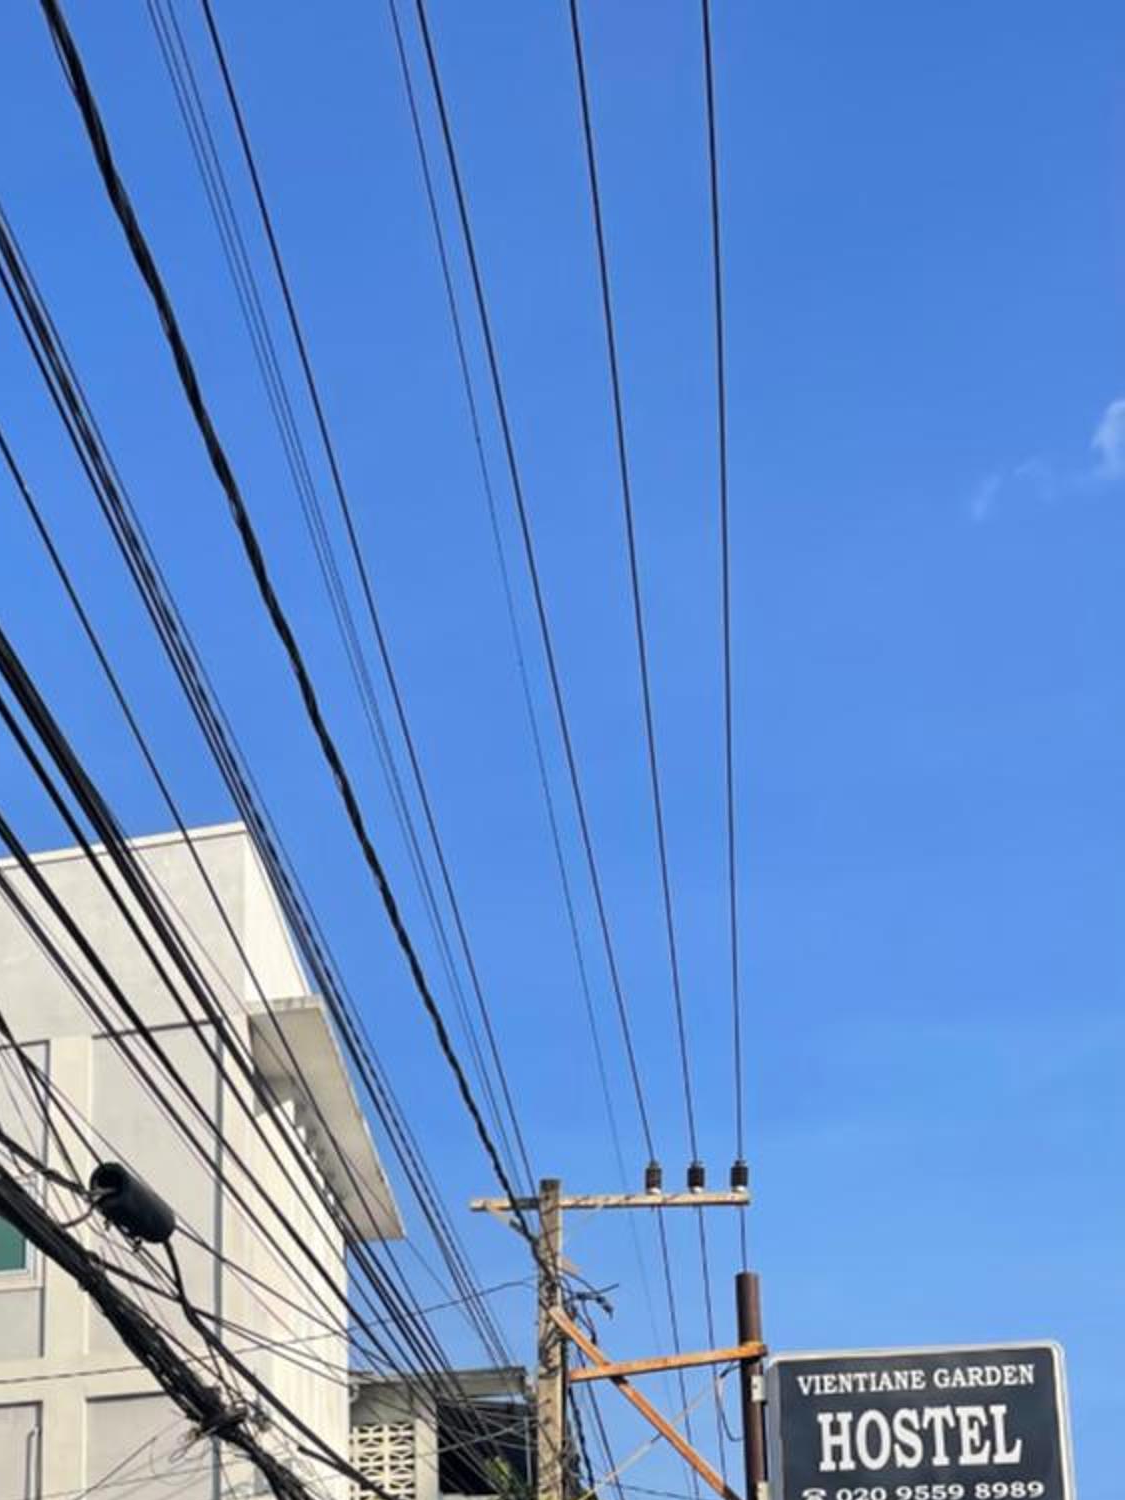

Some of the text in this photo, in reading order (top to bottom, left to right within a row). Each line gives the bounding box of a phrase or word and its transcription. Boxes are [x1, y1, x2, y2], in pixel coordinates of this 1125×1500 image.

[797, 1364, 1035, 1396] VIENTIANE GARDEN
[817, 1404, 1022, 1472] HOSTEL
[974, 1480, 1045, 1500] 8989
